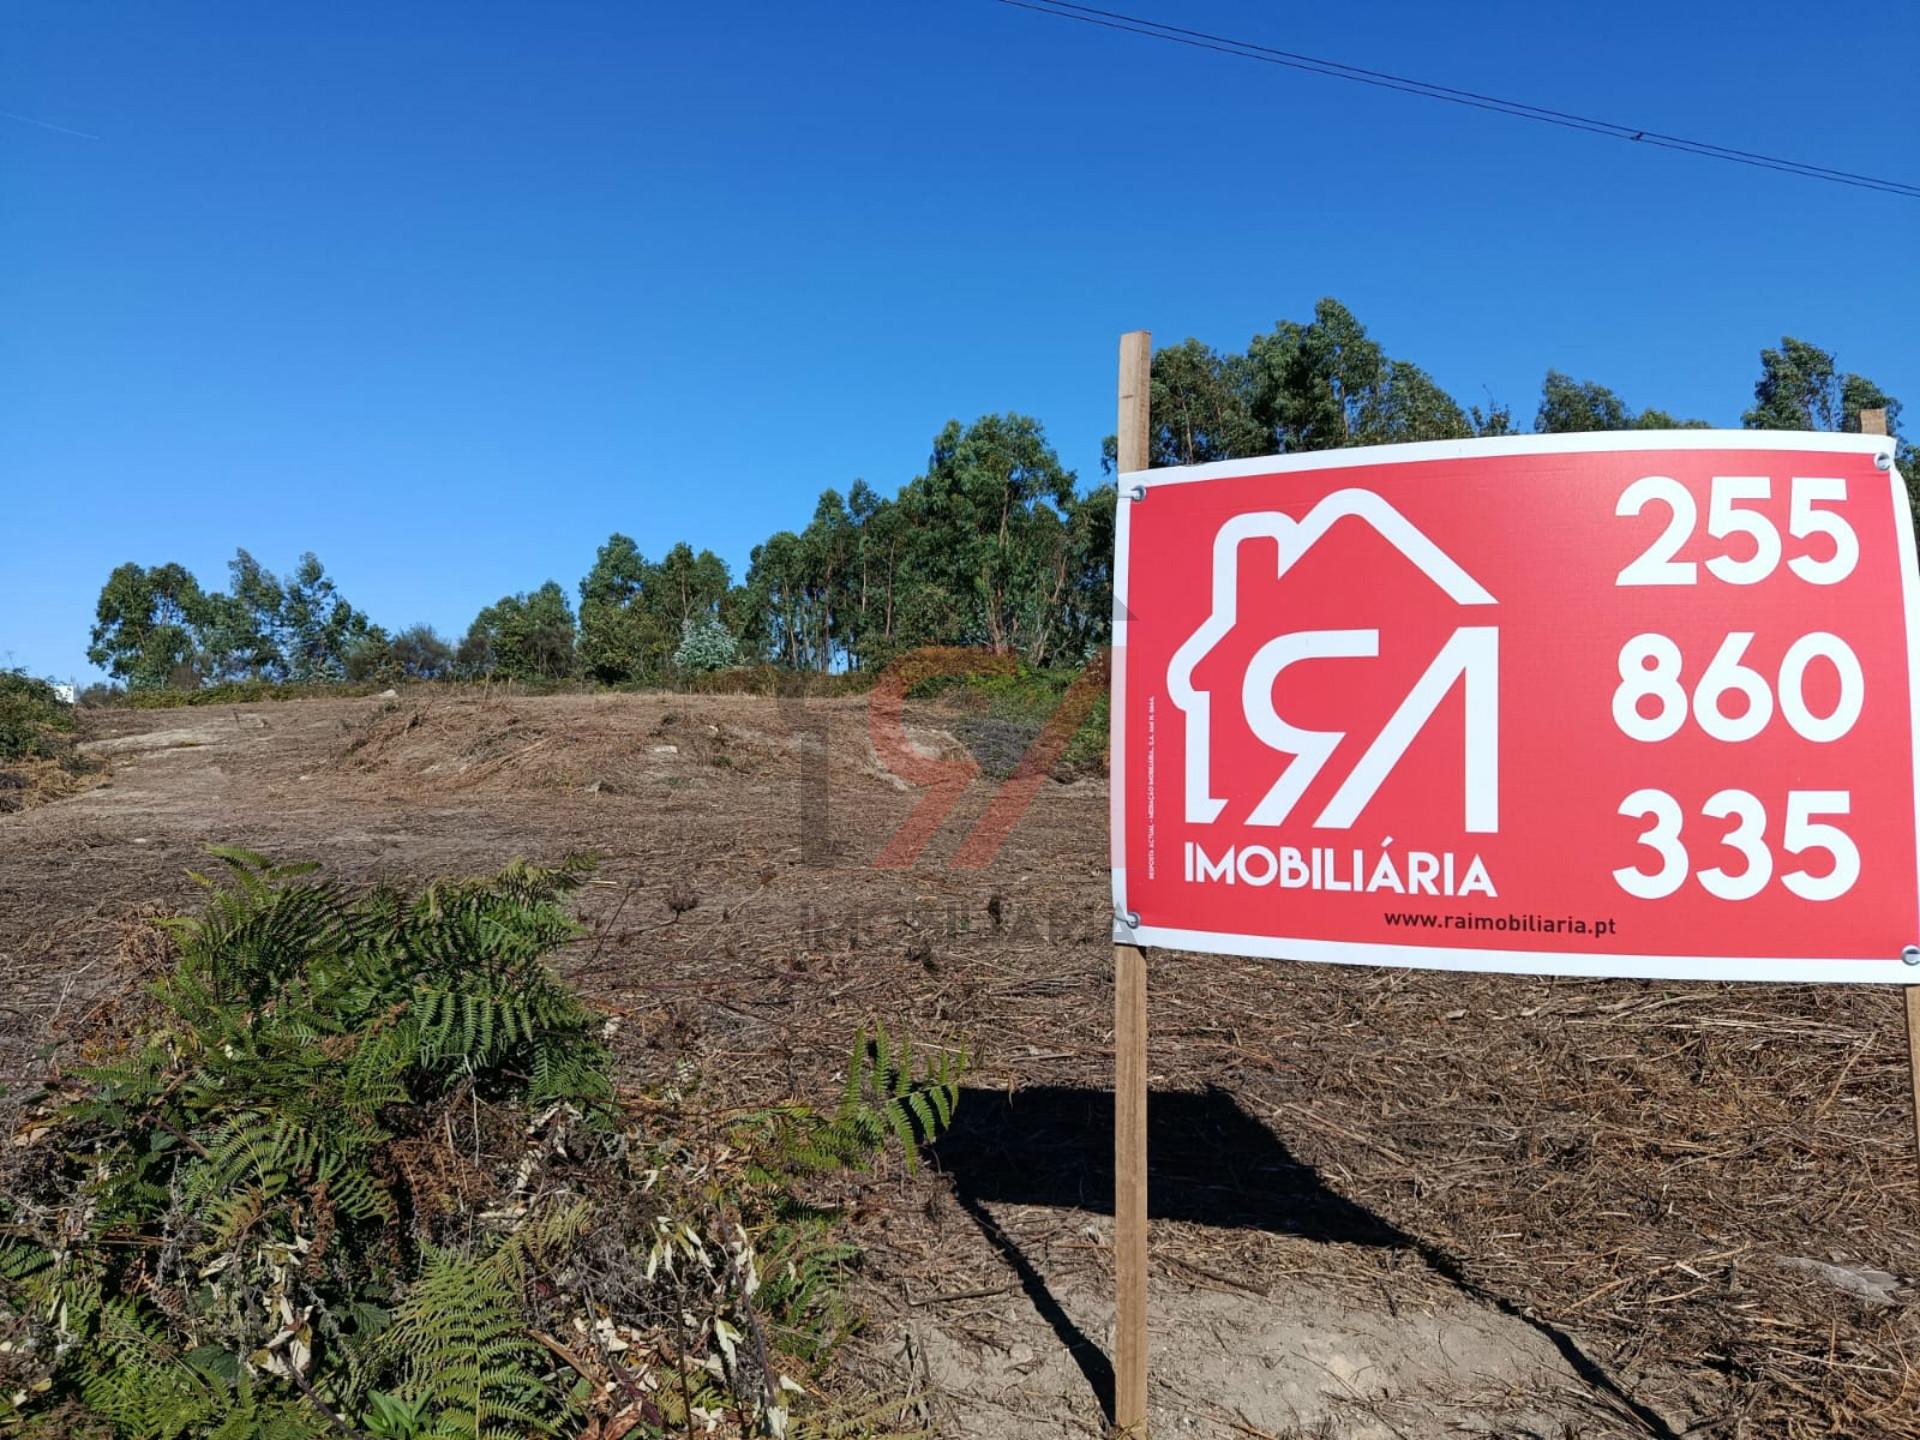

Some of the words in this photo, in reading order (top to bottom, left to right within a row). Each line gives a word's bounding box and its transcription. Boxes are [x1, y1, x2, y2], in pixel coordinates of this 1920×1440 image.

[1615, 475, 1860, 587] 255
[1612, 631, 1865, 743] 860
[1185, 835, 1498, 897] IMOBILIÁRIA
[1612, 788, 1861, 901] 335
[1384, 912, 1616, 938] www.raimobiliaria.pt
